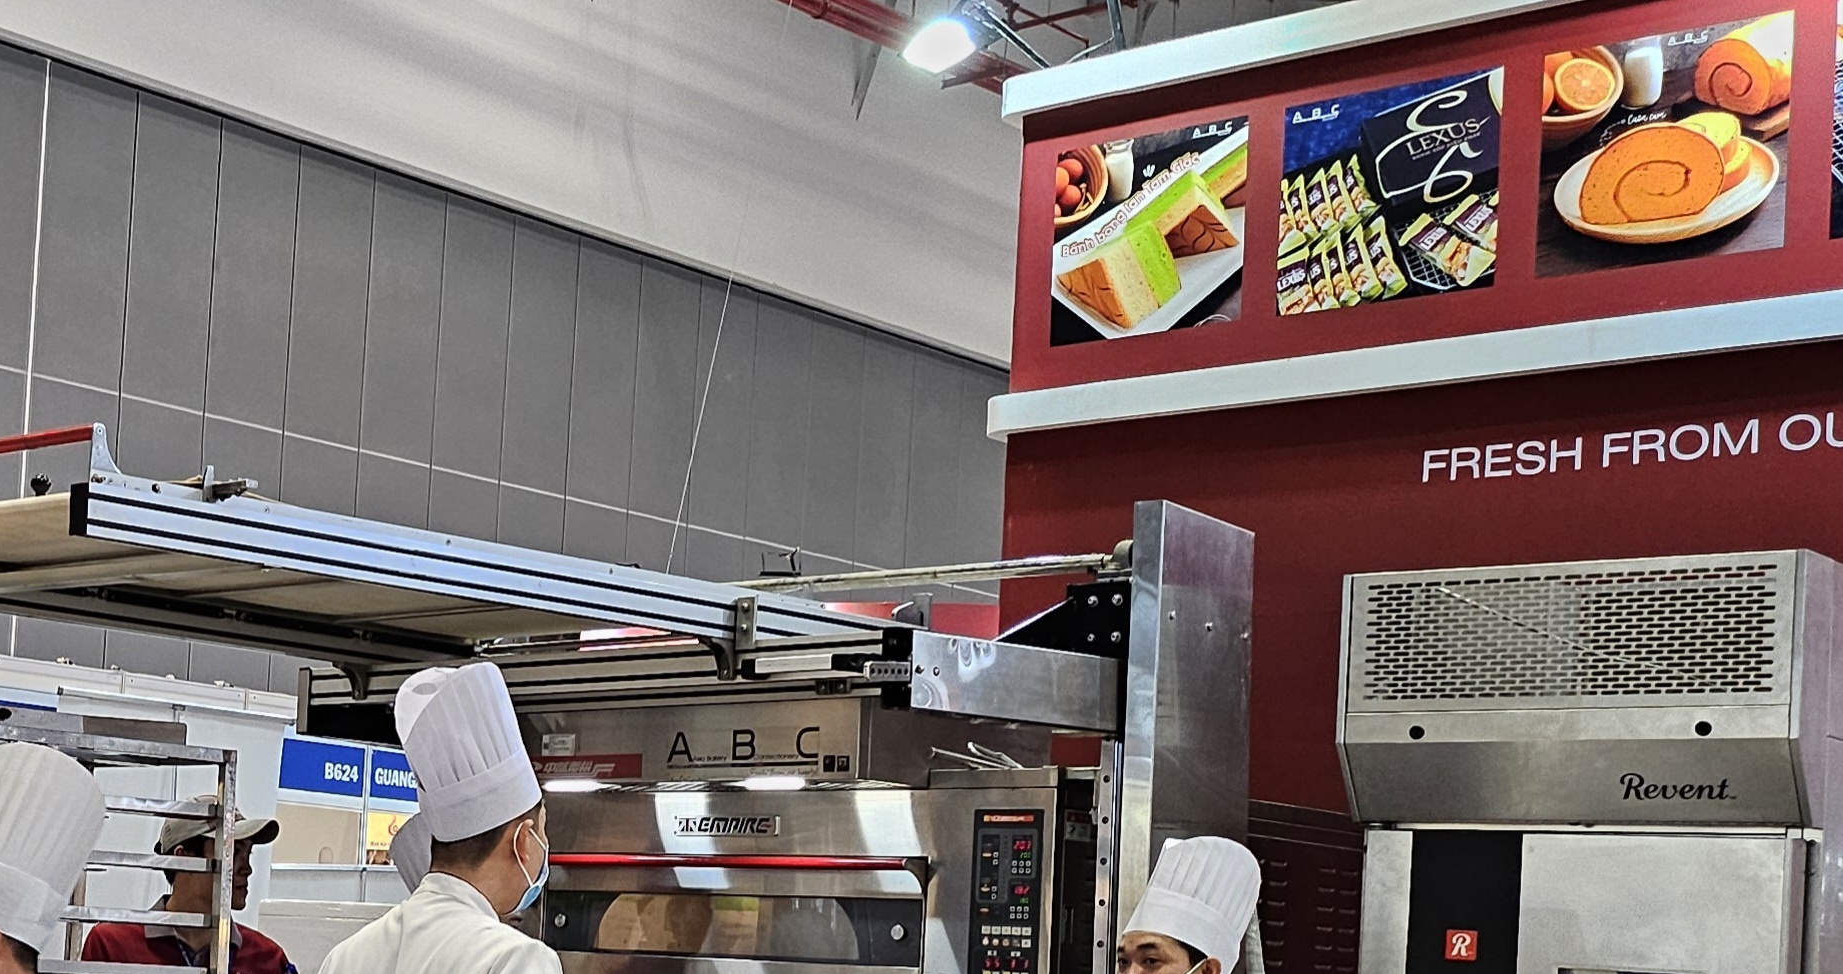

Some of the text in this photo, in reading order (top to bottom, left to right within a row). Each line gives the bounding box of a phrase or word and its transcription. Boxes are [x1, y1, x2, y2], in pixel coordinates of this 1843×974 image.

[1406, 118, 1482, 157] LEXUS
[1422, 436, 1583, 483] FRESH
[1602, 418, 1759, 468] FROM
[324, 762, 359, 783] B624
[374, 767, 418, 789] GUANG
[1619, 772, 1729, 801] Revent
[697, 816, 773, 834] EMPIRE
[1451, 932, 1472, 957] R
